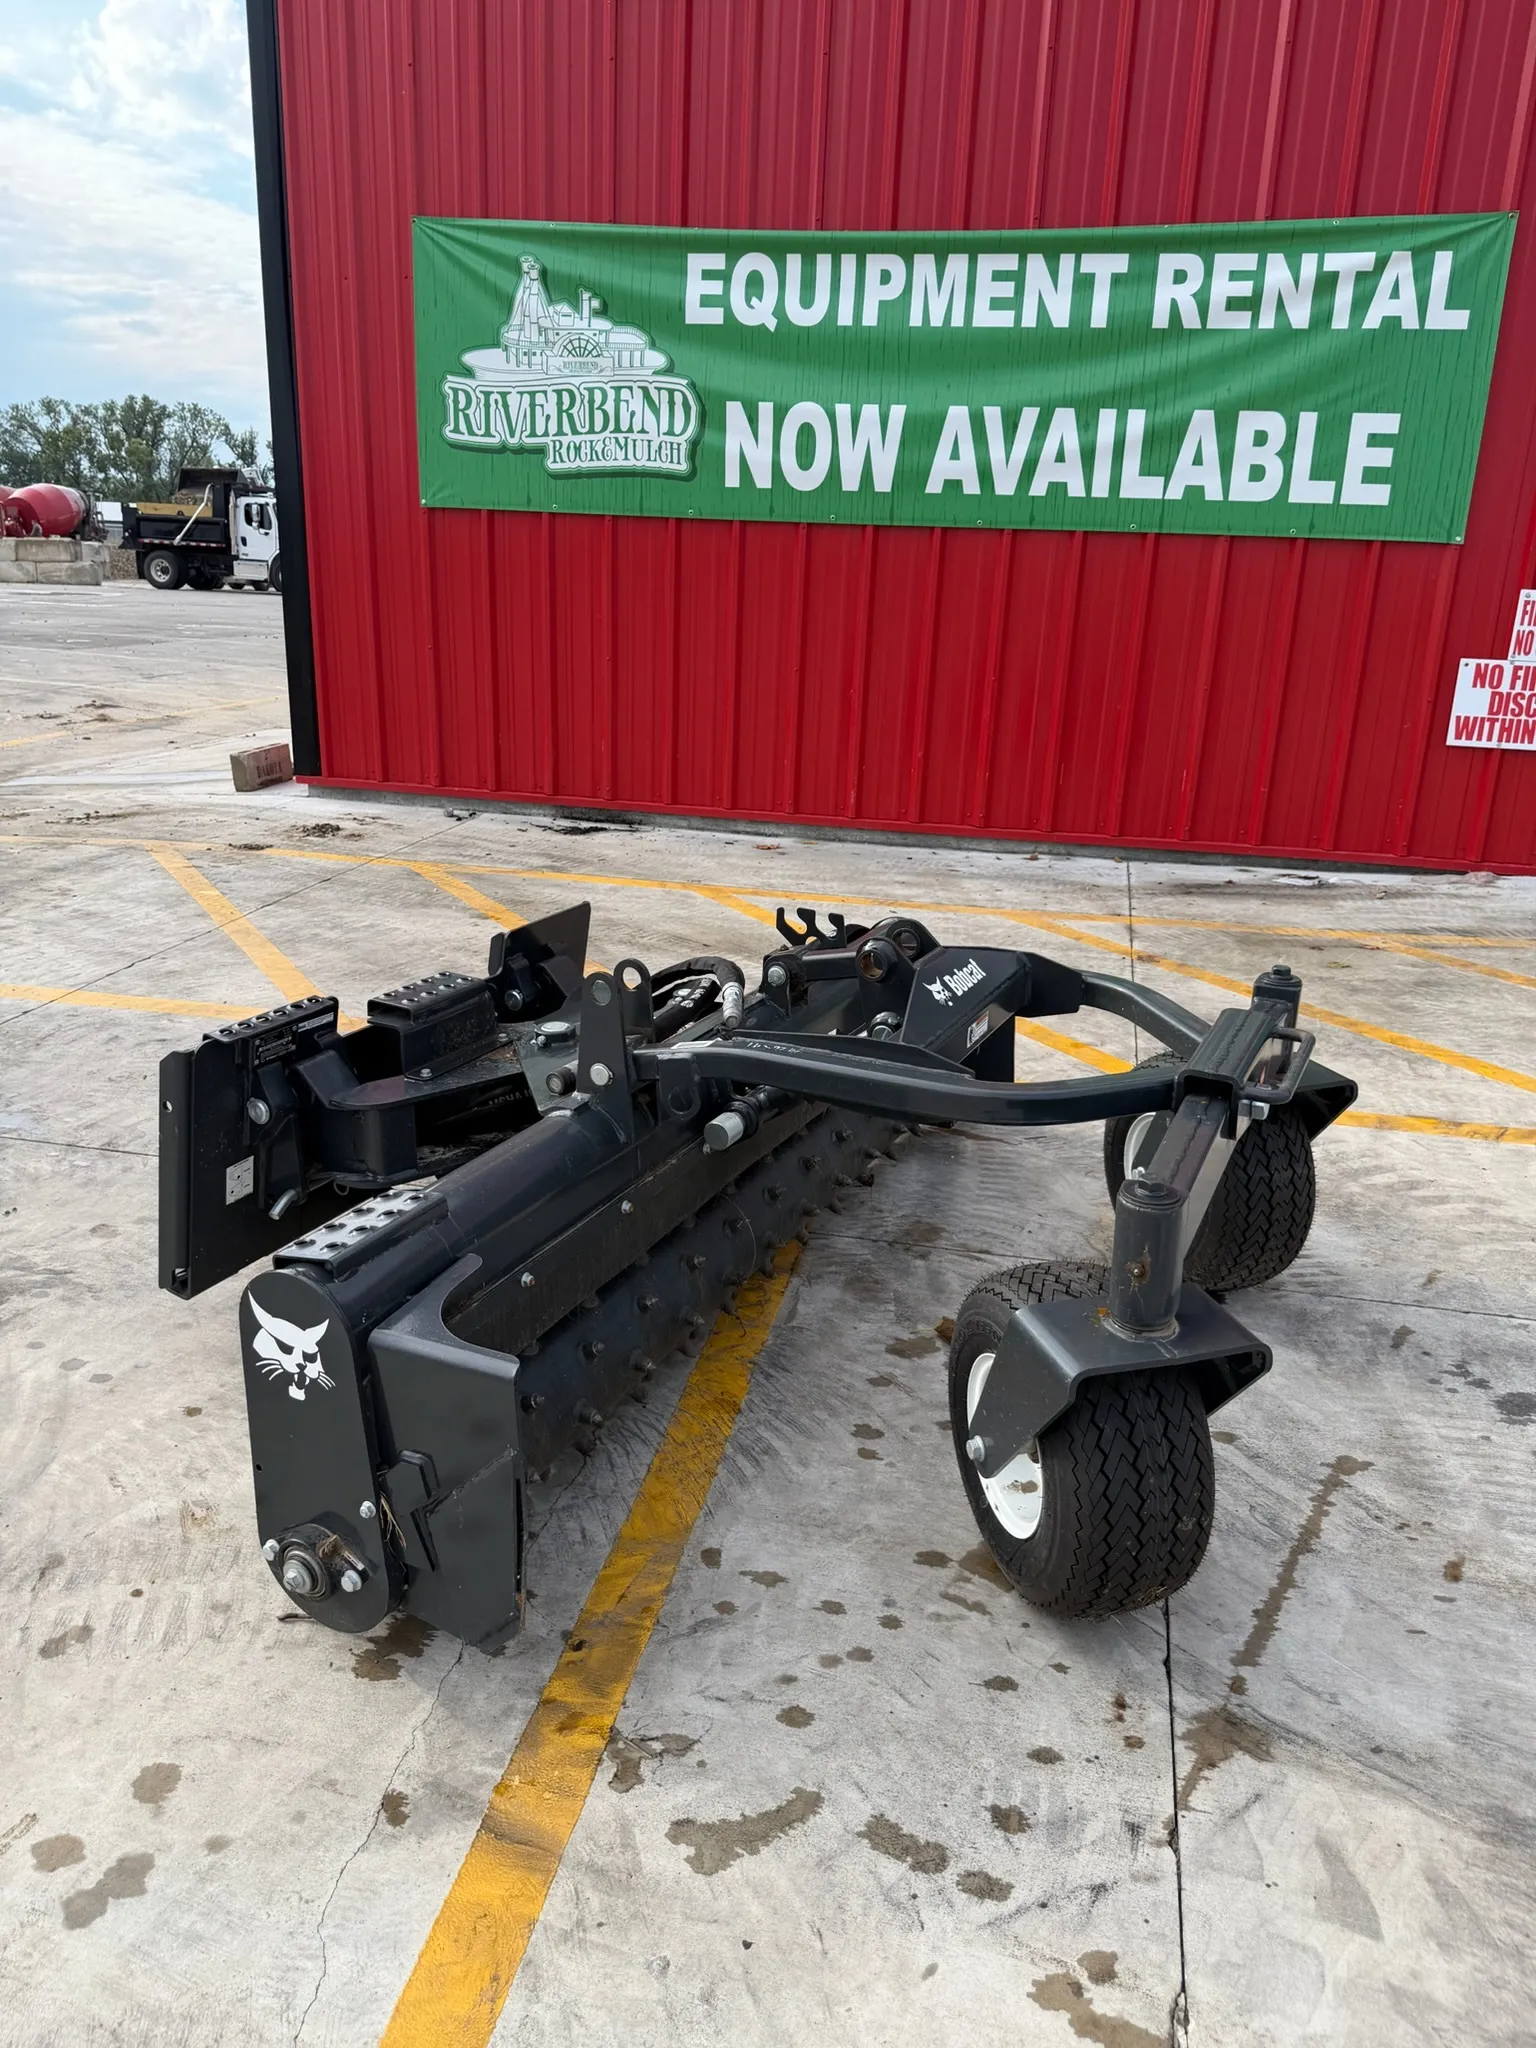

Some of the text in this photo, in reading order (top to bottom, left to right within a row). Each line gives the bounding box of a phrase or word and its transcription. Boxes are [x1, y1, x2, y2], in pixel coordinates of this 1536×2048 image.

[686, 250, 1471, 333] EQUIPMENT RENTAL
[448, 386, 692, 438] RIVERBEND
[724, 400, 1401, 506] NOW AVAILABLE
[1513, 629, 1535, 656] NO
[1471, 662, 1505, 690] NO
[1454, 715, 1536, 745] WITHIN
[943, 958, 987, 997] Bobcat
